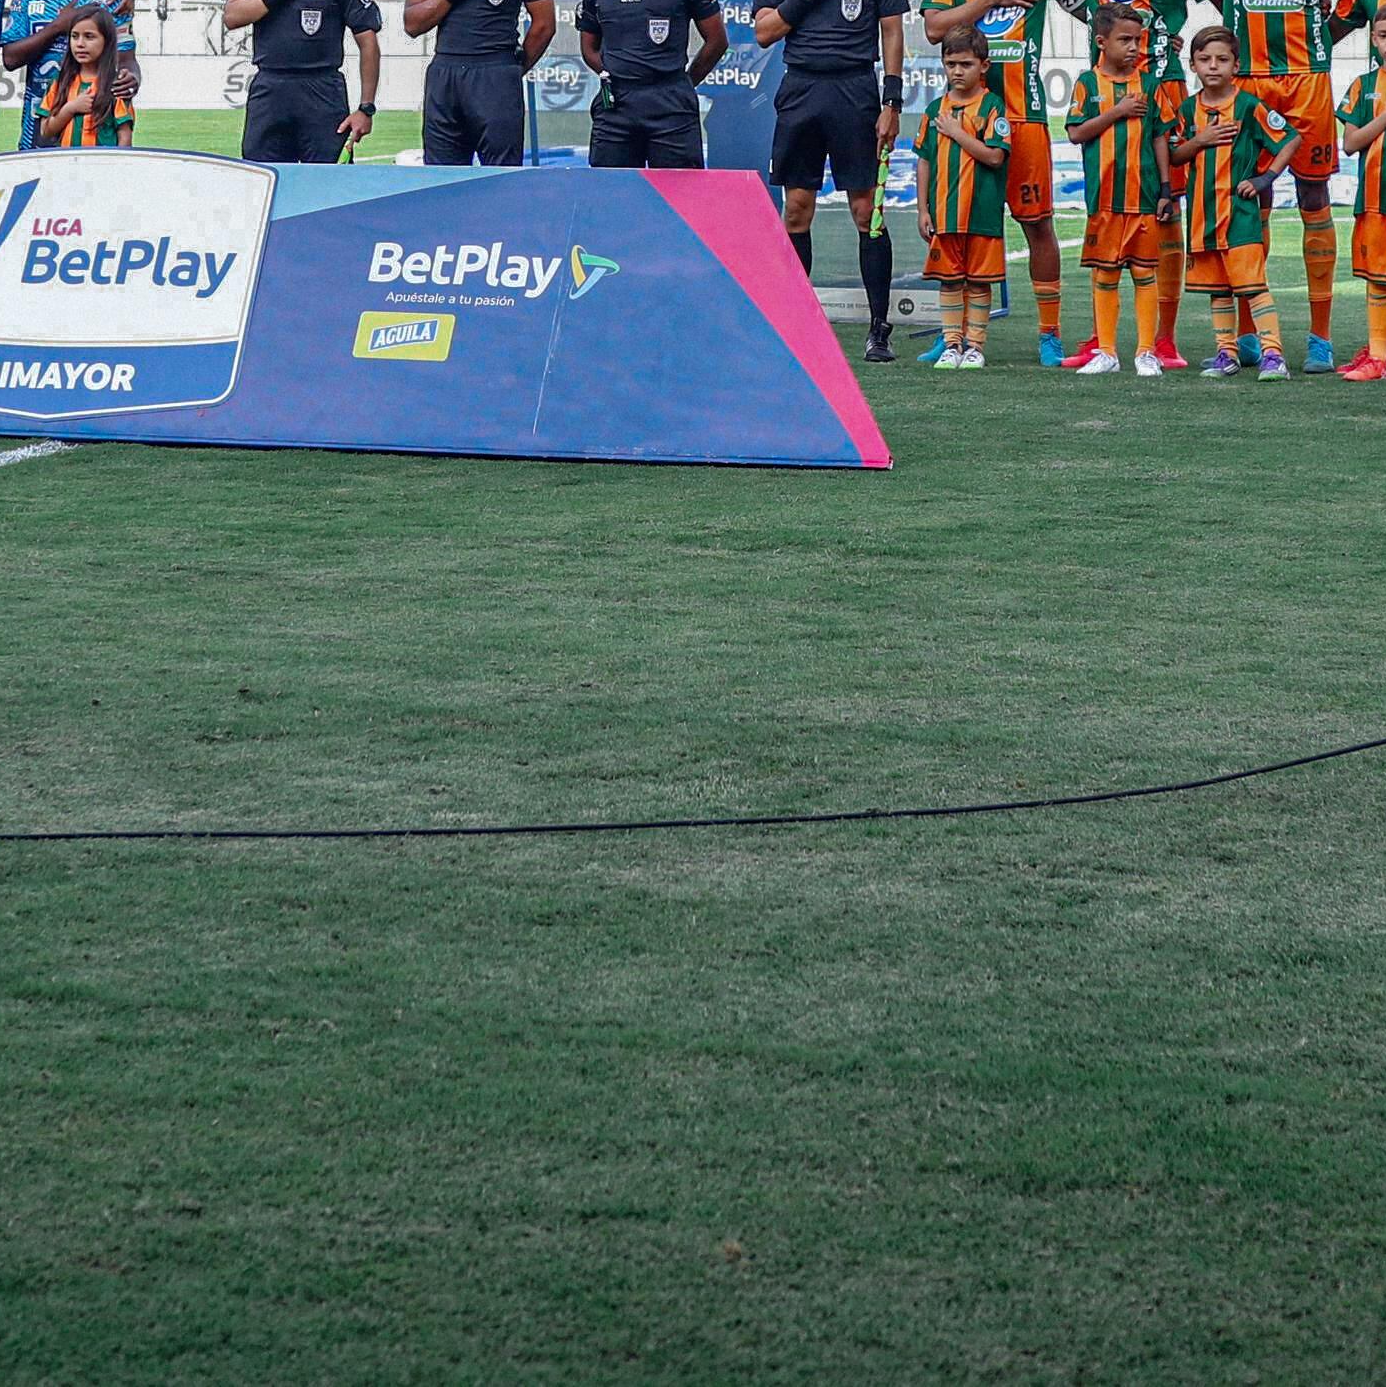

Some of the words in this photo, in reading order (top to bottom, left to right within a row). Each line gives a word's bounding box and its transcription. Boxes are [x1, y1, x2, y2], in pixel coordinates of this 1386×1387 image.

[1313, 6, 1326, 61] BetPlay
[988, 47, 1023, 57] anta
[525, 67, 580, 86] etPlay
[703, 68, 761, 88] etPlay
[1028, 55, 1041, 111] BetPlay
[1019, 184, 1041, 205] 21
[32, 218, 83, 236] LIGA
[21, 237, 238, 299] BetPlay
[368, 241, 563, 298] BetPlay
[385, 290, 445, 304] Apuéstale
[448, 295, 456, 303] a
[459, 294, 472, 304] tu
[475, 295, 515, 307] pasión
